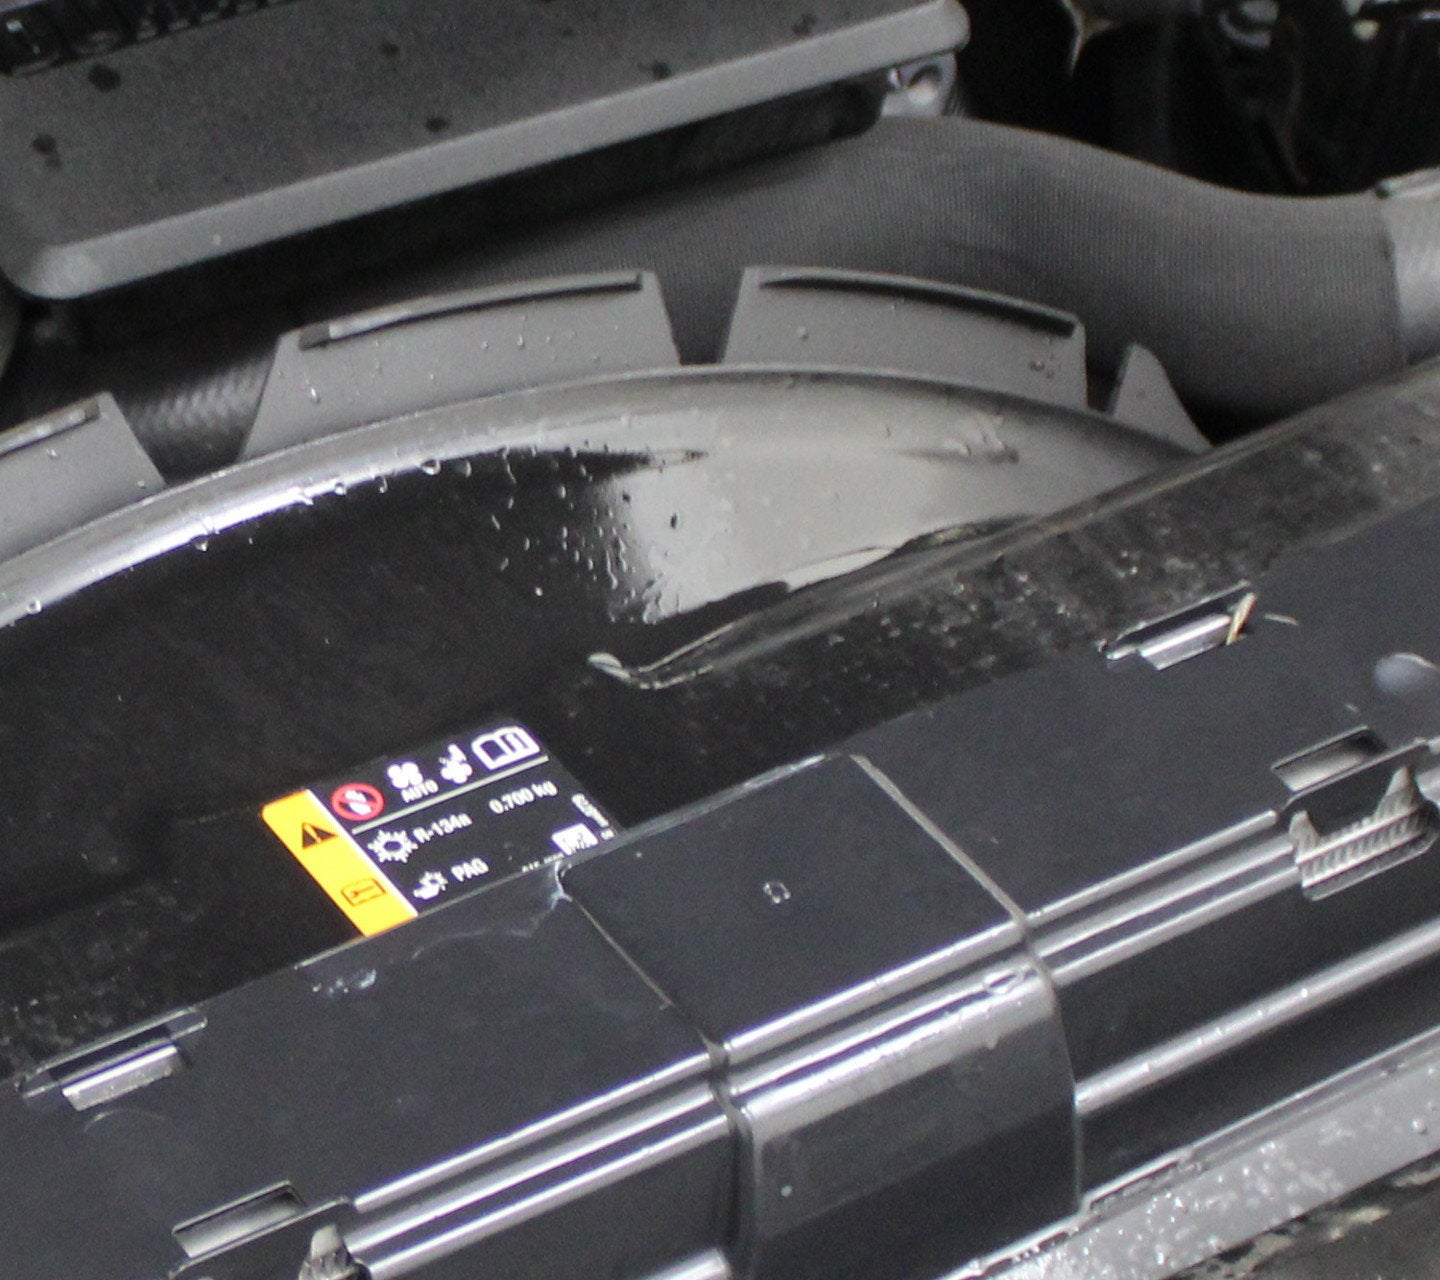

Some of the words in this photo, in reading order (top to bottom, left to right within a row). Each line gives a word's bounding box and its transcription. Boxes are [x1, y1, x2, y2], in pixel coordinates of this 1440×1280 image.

[401, 779, 439, 803] AUTO
[489, 787, 534, 814] 0.700
[450, 857, 490, 882] PAG
